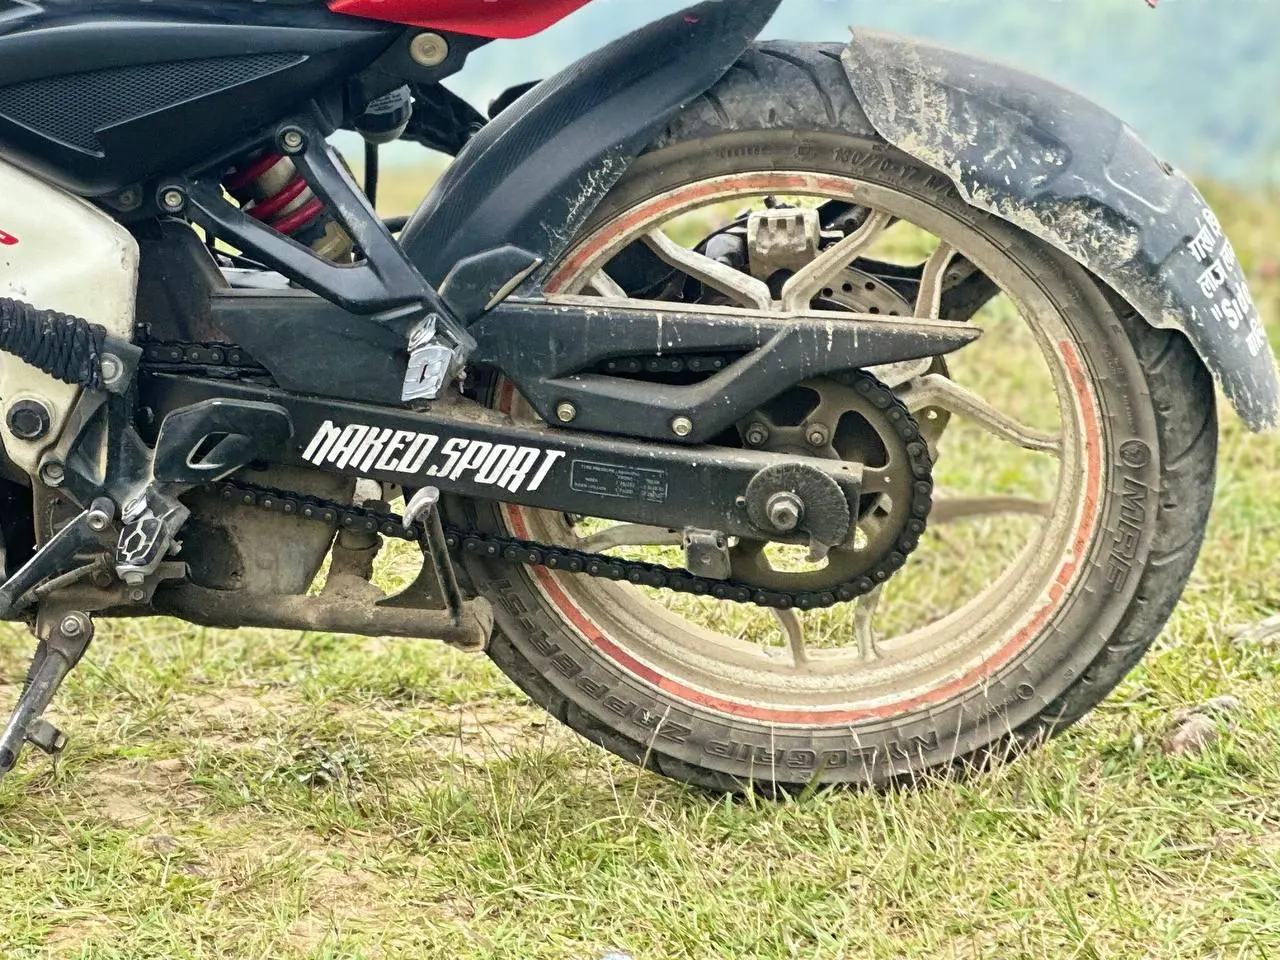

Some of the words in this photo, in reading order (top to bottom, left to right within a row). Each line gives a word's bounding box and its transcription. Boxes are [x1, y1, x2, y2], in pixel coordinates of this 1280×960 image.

[301, 420, 438, 473] NAKED
[426, 441, 566, 494] SPORT
[1094, 476, 1151, 594] MRF
[698, 727, 944, 770] NYLOGRIP
